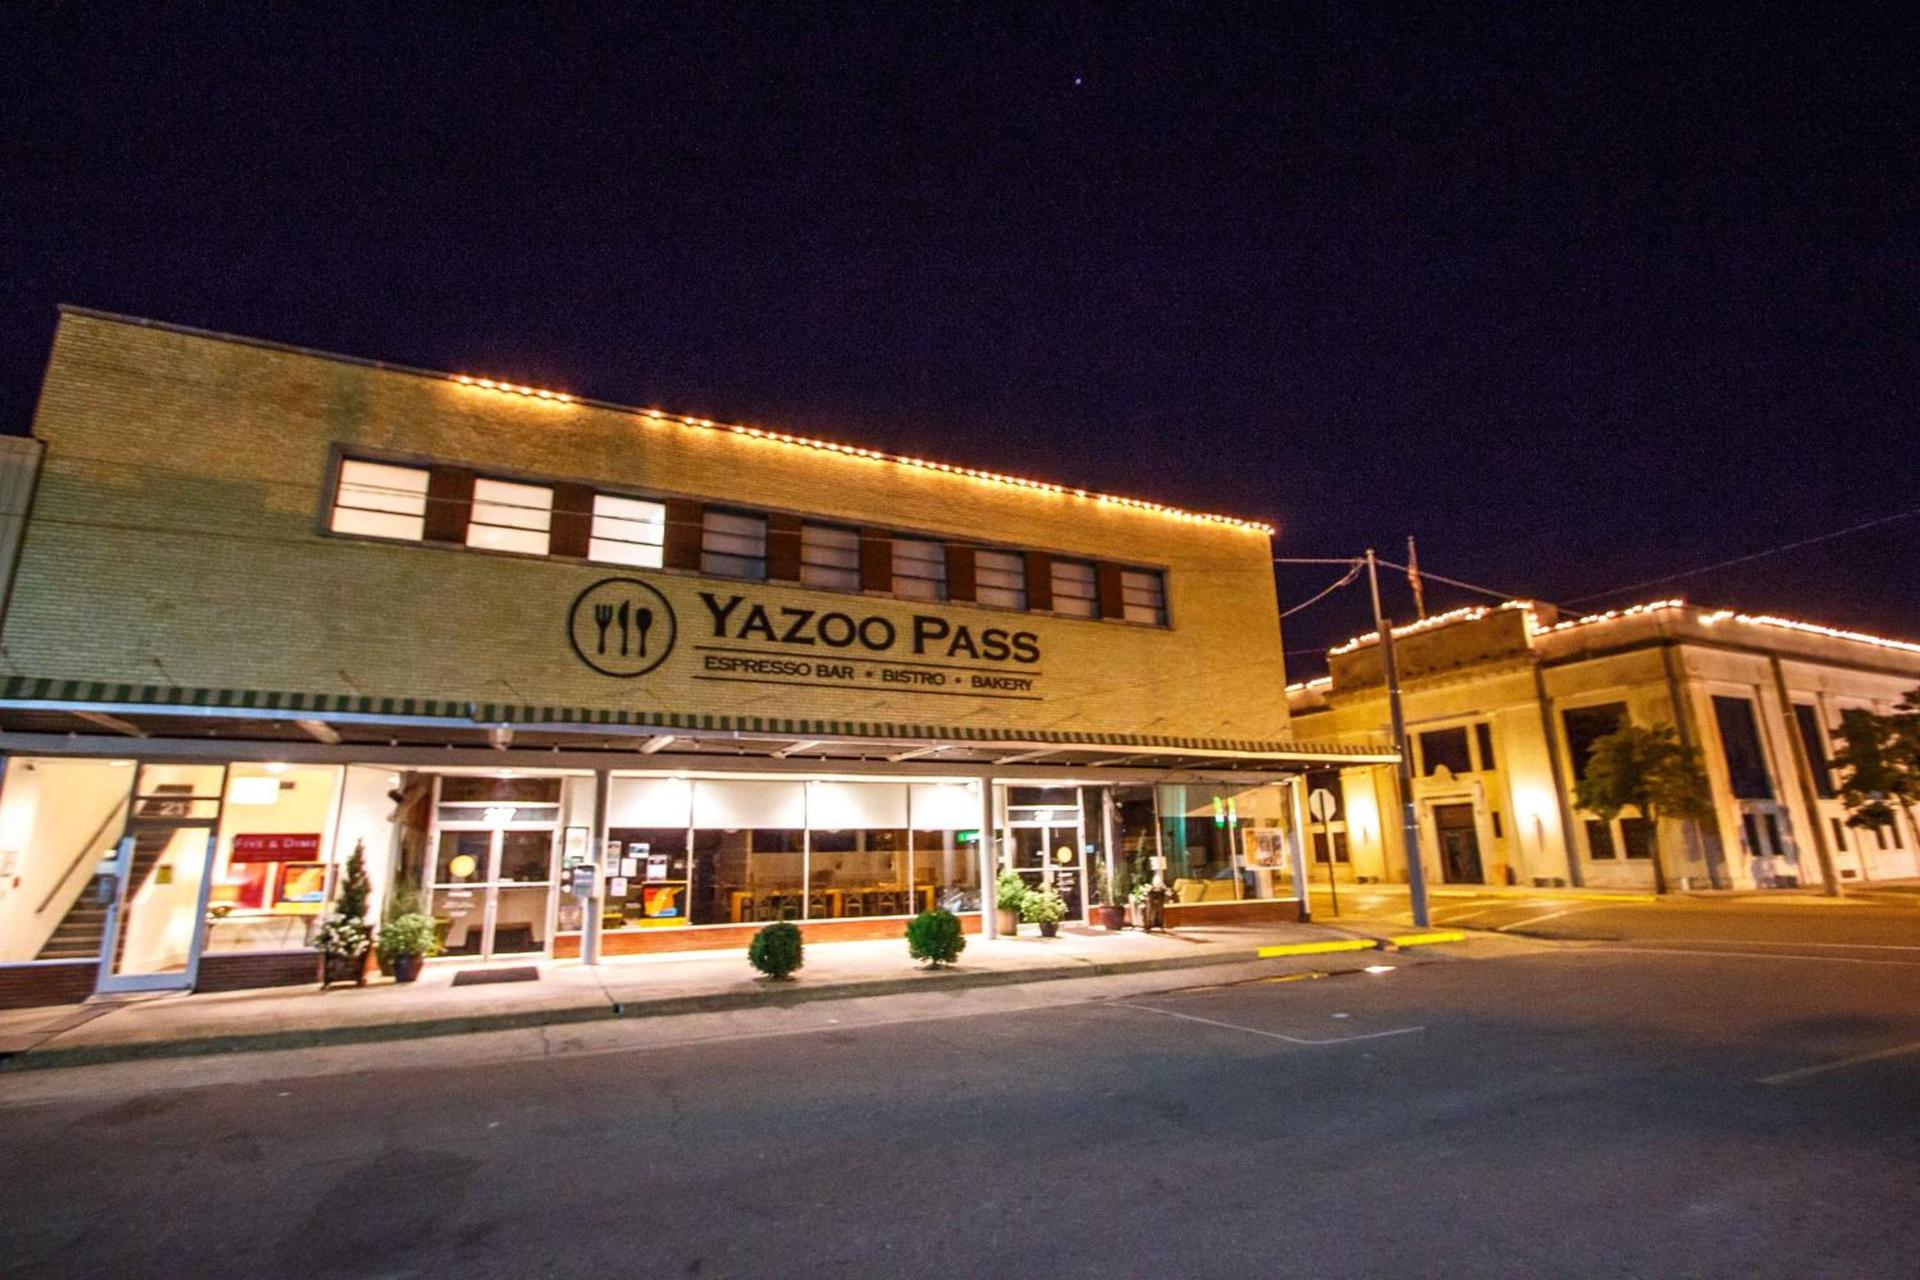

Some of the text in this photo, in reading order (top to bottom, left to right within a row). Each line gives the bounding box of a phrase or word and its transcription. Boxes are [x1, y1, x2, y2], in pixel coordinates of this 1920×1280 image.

[698, 592, 1041, 664] YAZOO PASS
[705, 656, 1033, 691] ESPRESSO BAR BISTRO BAKERY
